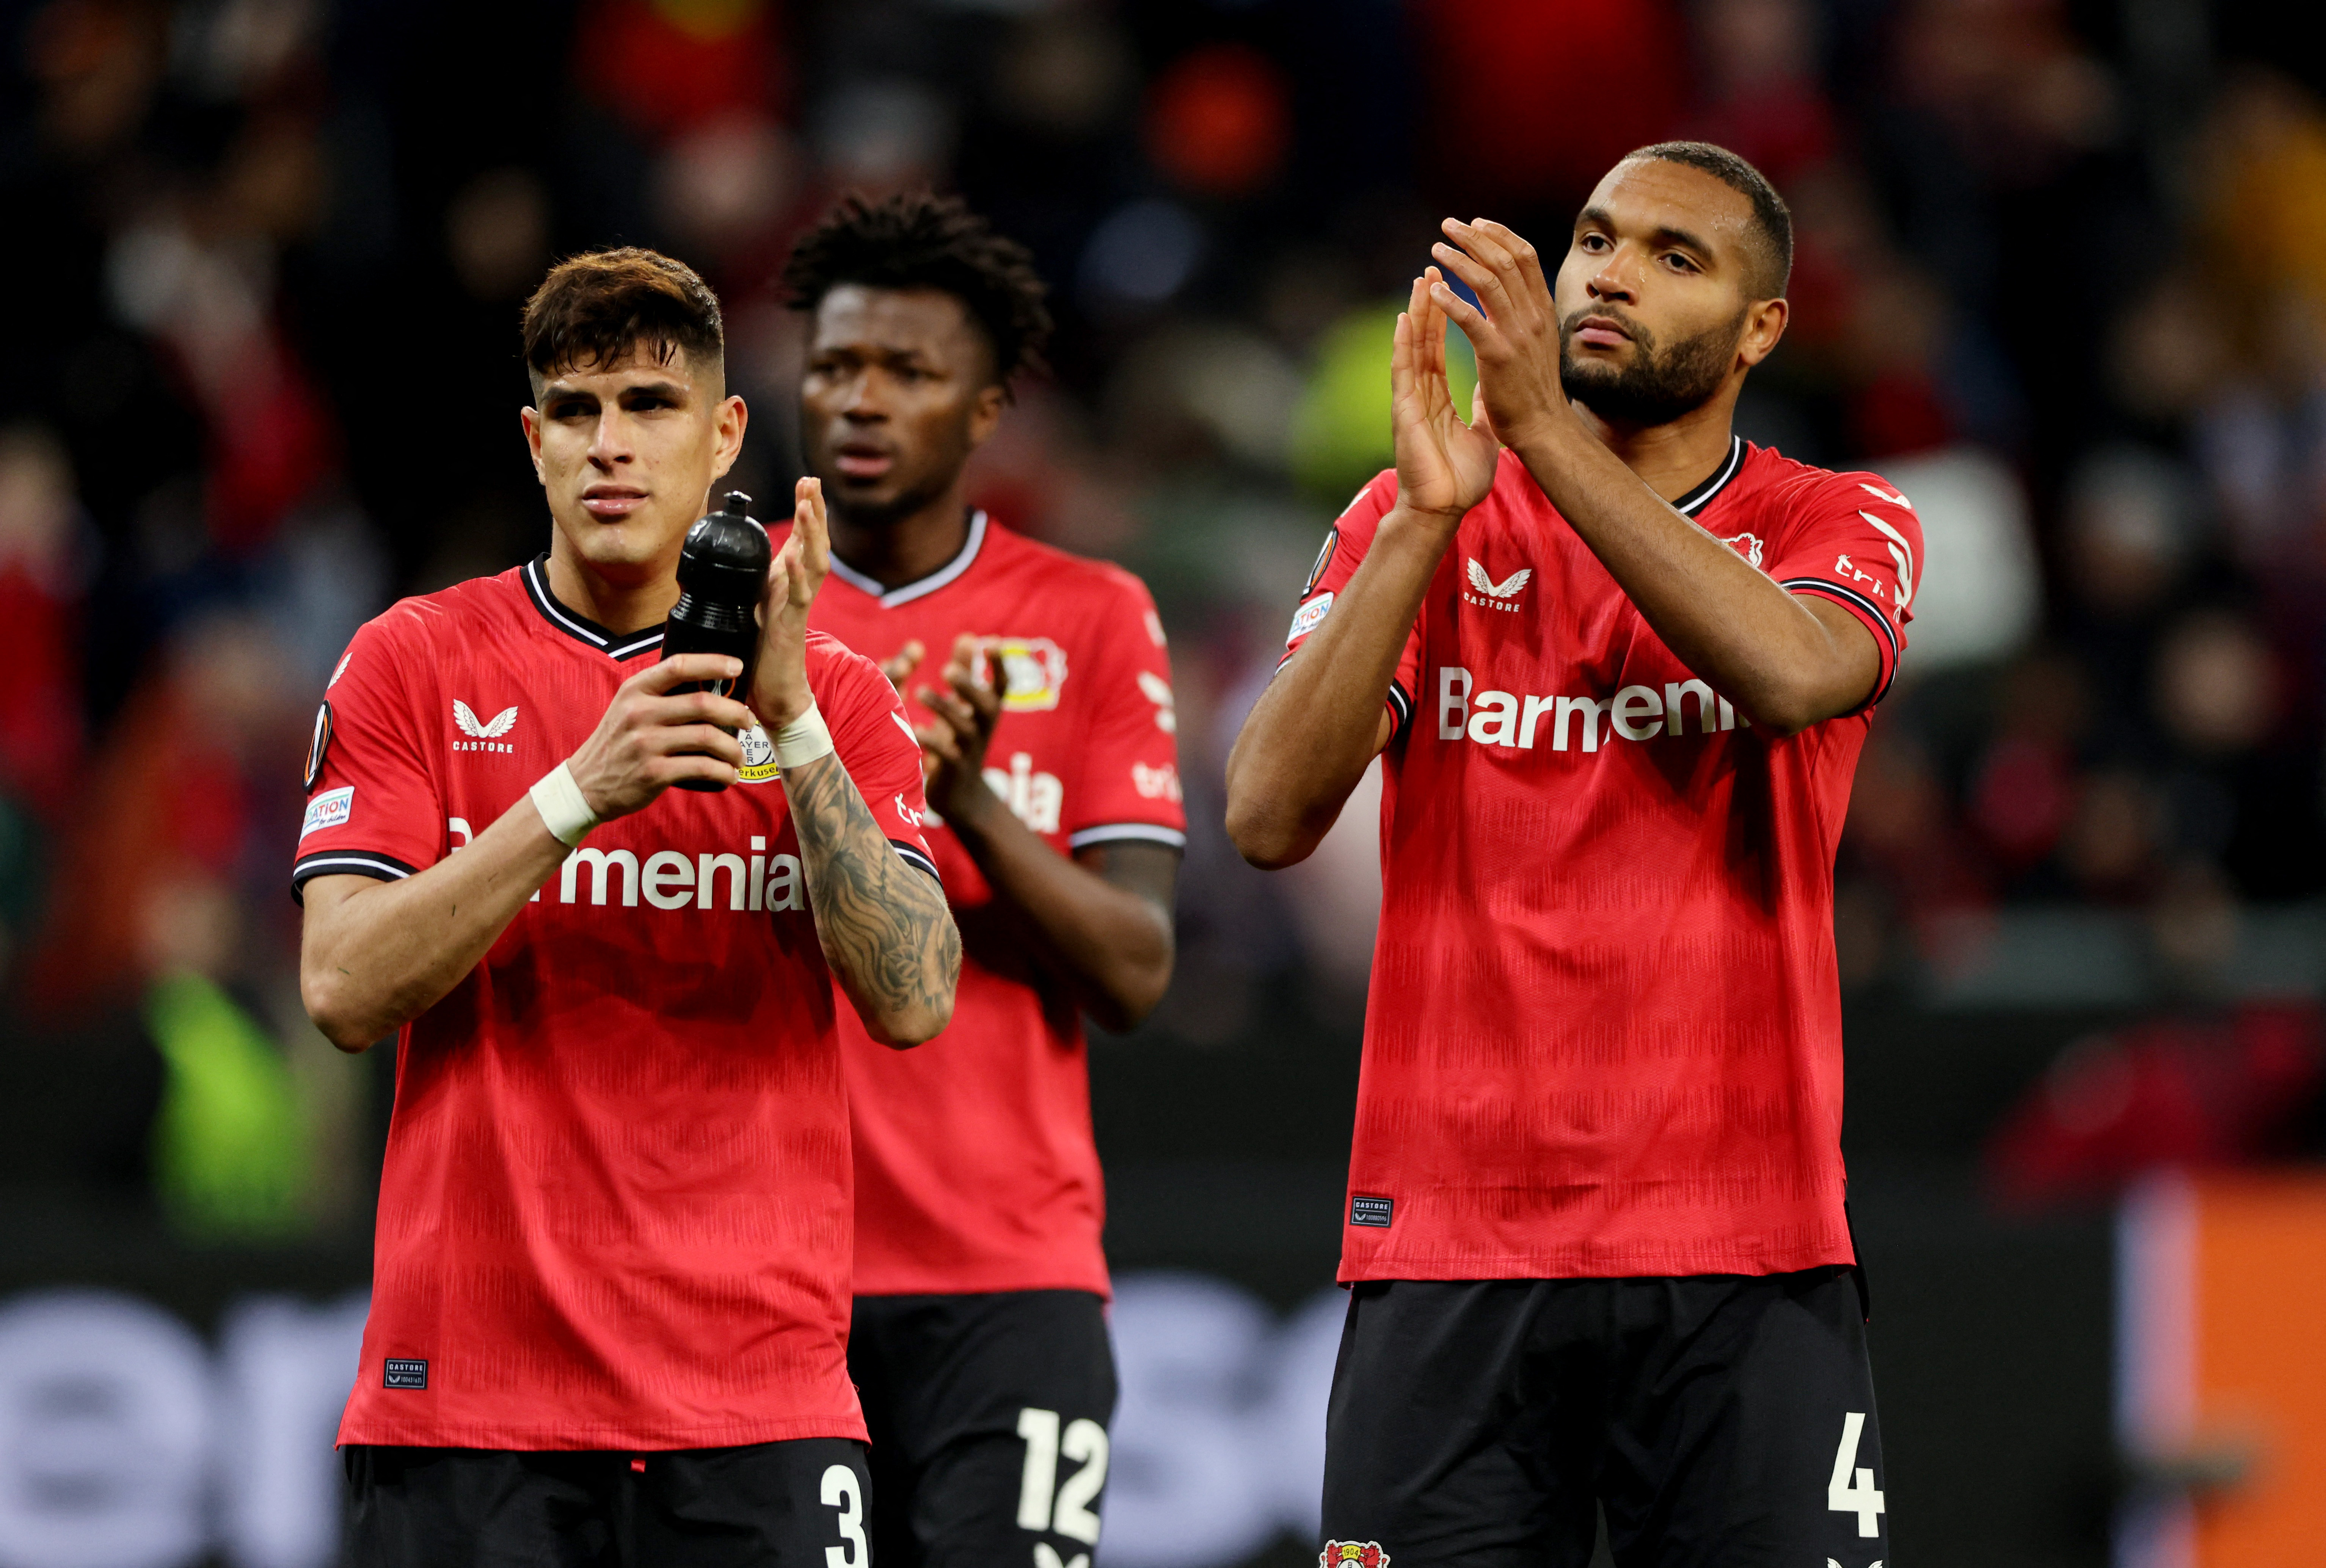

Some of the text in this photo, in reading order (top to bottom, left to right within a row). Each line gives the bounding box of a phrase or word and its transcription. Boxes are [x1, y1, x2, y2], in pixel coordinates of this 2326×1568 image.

[1464, 592, 1520, 612] CASTORE
[1293, 603, 1329, 629] ATION
[1439, 666, 1752, 752] Barmen
[453, 741, 513, 754] CASTORE
[739, 767, 778, 777] erkuse
[327, 814, 346, 823] children
[895, 792, 924, 827] tr
[1017, 1407, 1109, 1546] 12
[1828, 1412, 1885, 1538] 4
[821, 1464, 869, 1568] 3
[1343, 1548, 1358, 1556] 1904
